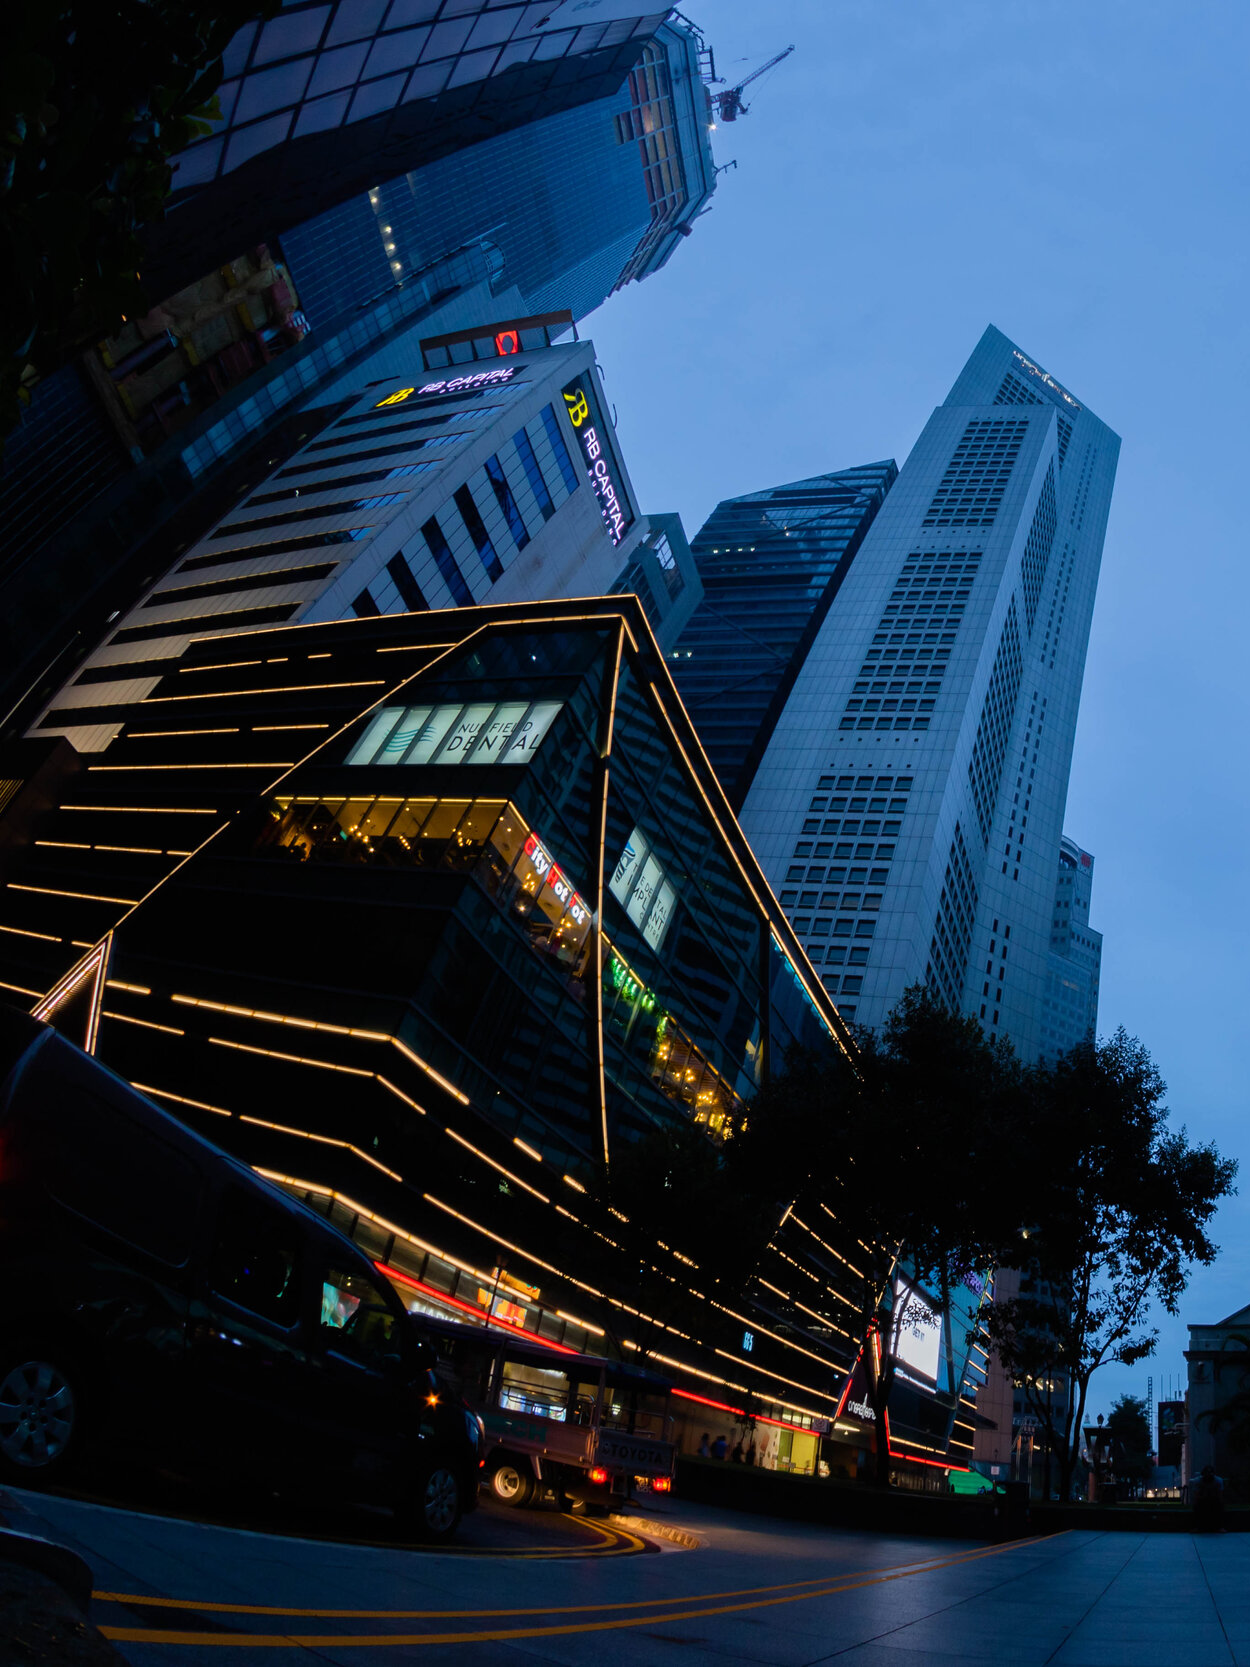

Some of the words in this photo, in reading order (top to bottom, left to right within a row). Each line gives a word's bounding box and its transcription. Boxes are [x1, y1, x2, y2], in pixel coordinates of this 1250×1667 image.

[418, 381, 446, 394] RB
[446, 367, 514, 388] CAPITAL
[584, 427, 600, 459] RB
[595, 460, 625, 540] CAPITAL
[588, 469, 618, 546] BUIDING
[458, 721, 533, 733] NUFIELD
[447, 734, 540, 751] DENTAL
[524, 832, 549, 875] City
[546, 862, 569, 902] Hot
[645, 886, 667, 920] DETAL
[612, 1444, 662, 1463] TOYOTA
